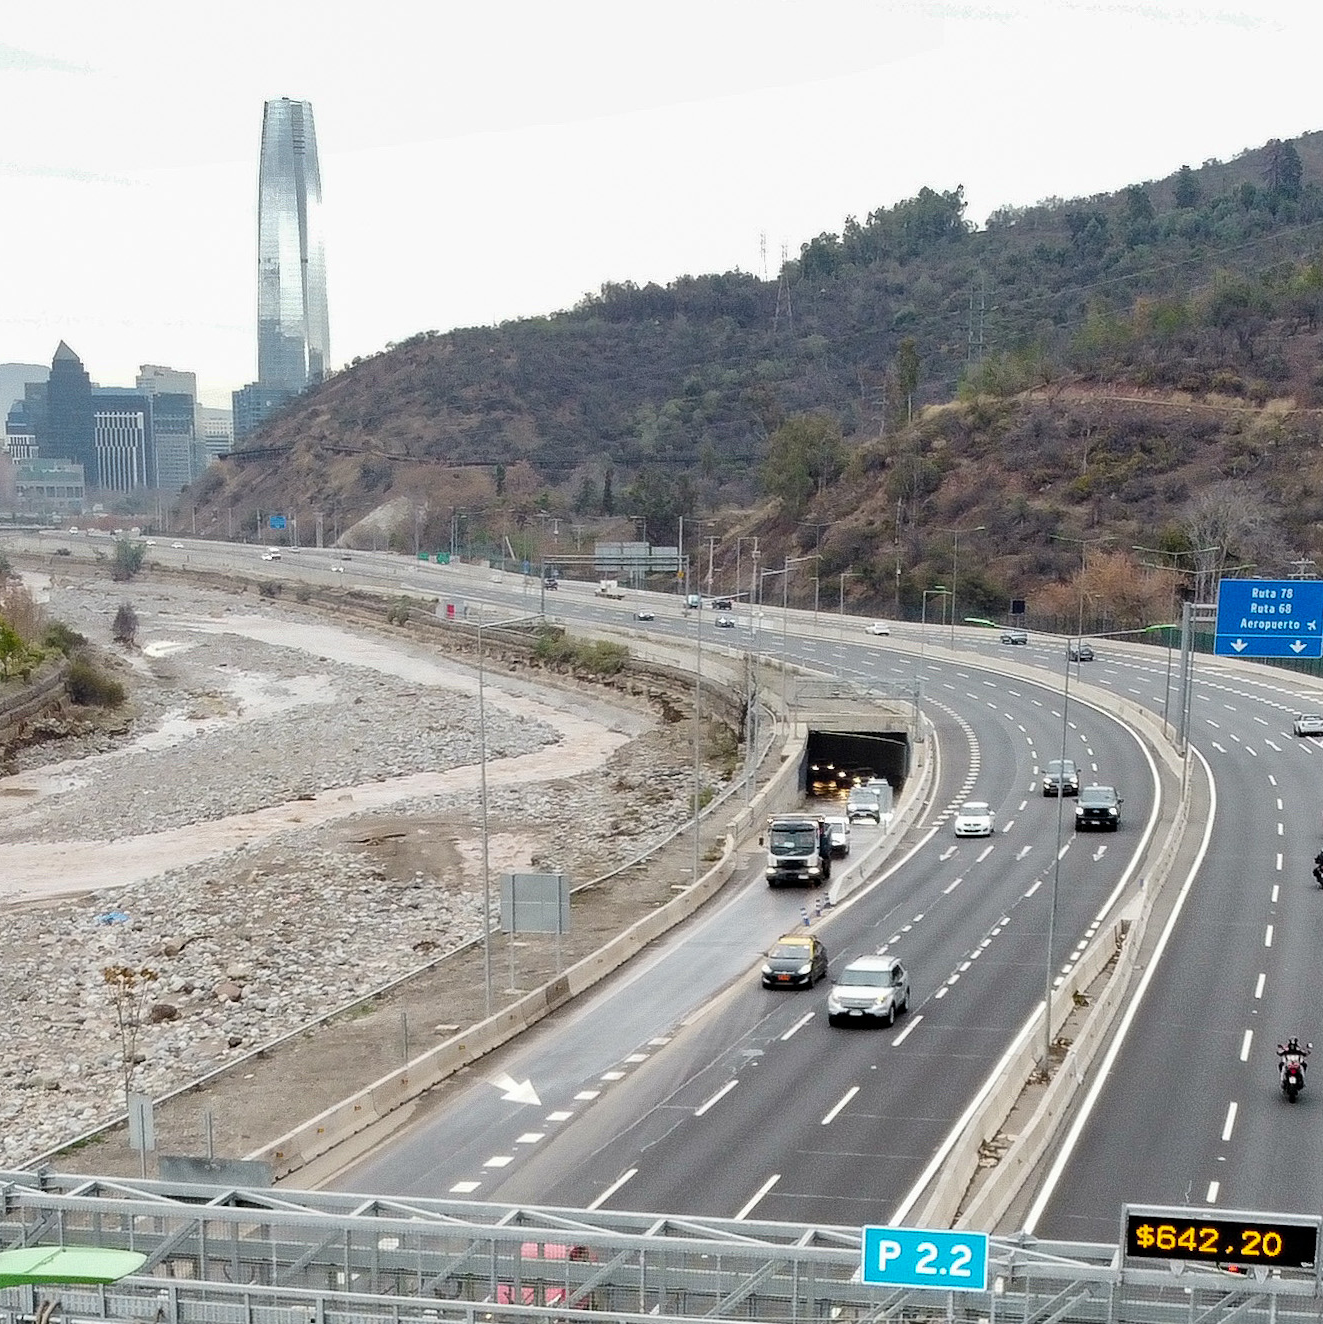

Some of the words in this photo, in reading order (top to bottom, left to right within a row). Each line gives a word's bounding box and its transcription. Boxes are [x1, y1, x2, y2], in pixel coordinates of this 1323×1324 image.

[1252, 587, 1277, 599] Ruta
[1280, 588, 1294, 599] 78
[1250, 602, 1276, 614] Ruta
[1278, 603, 1292, 614] 68
[1240, 617, 1301, 631] Aeropuerto
[878, 1239, 902, 1272] P
[915, 1241, 973, 1278] 2.2
